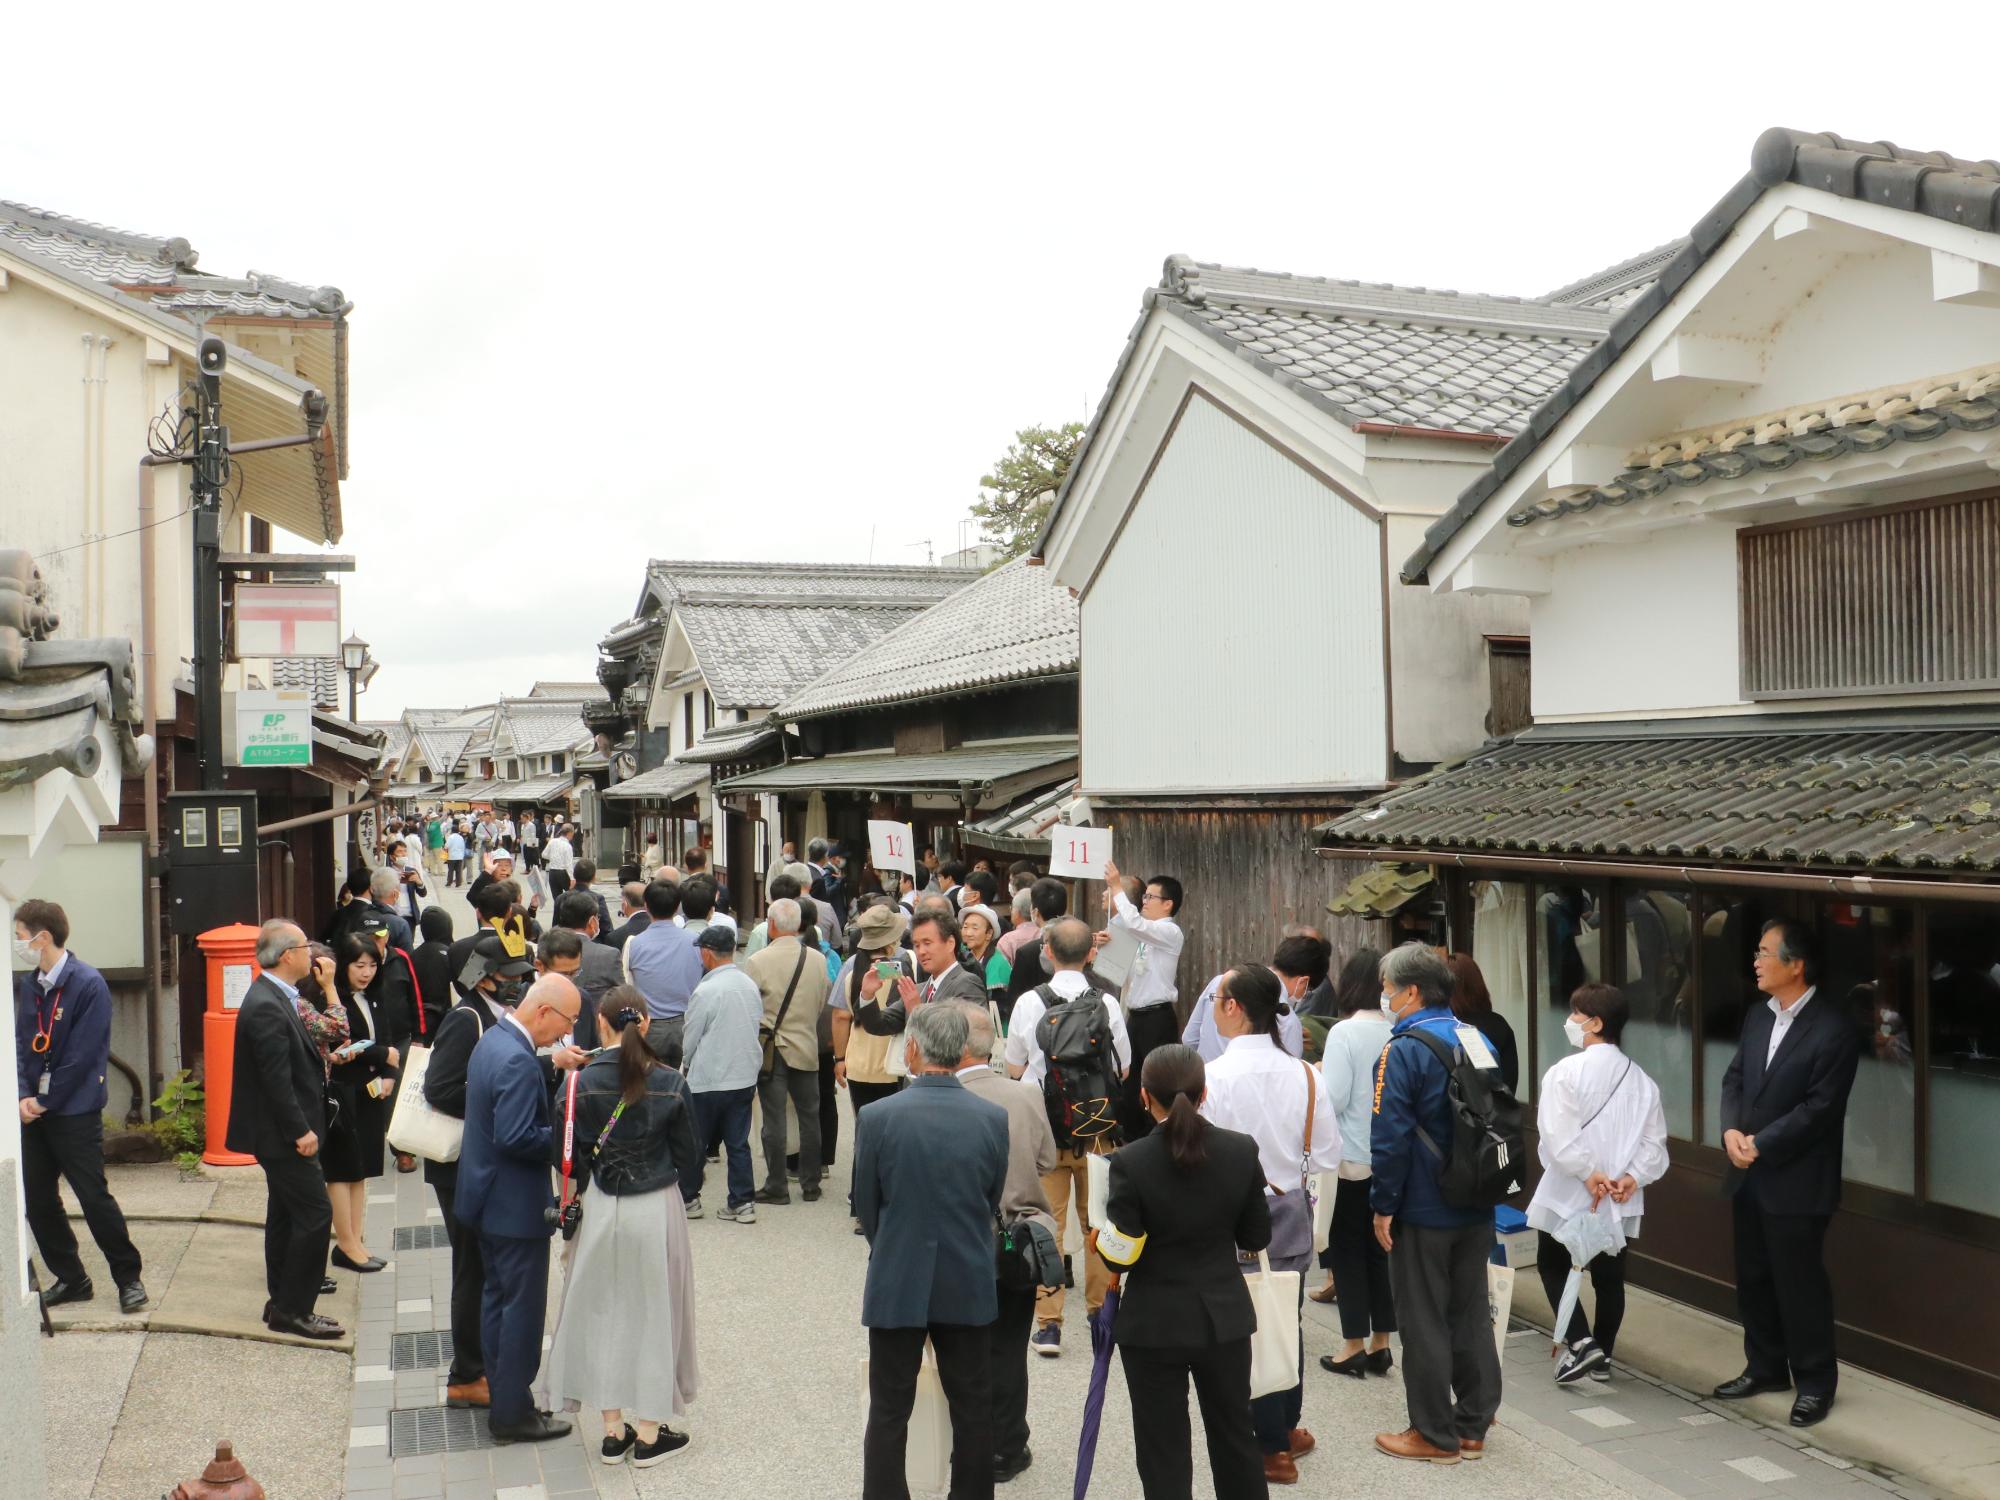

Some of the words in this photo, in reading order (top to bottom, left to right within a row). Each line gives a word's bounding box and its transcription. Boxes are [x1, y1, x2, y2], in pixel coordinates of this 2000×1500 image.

[248, 733, 301, 743] ゆうちょ銀行
[886, 834, 904, 857] 12
[1068, 840, 1090, 864] 11
